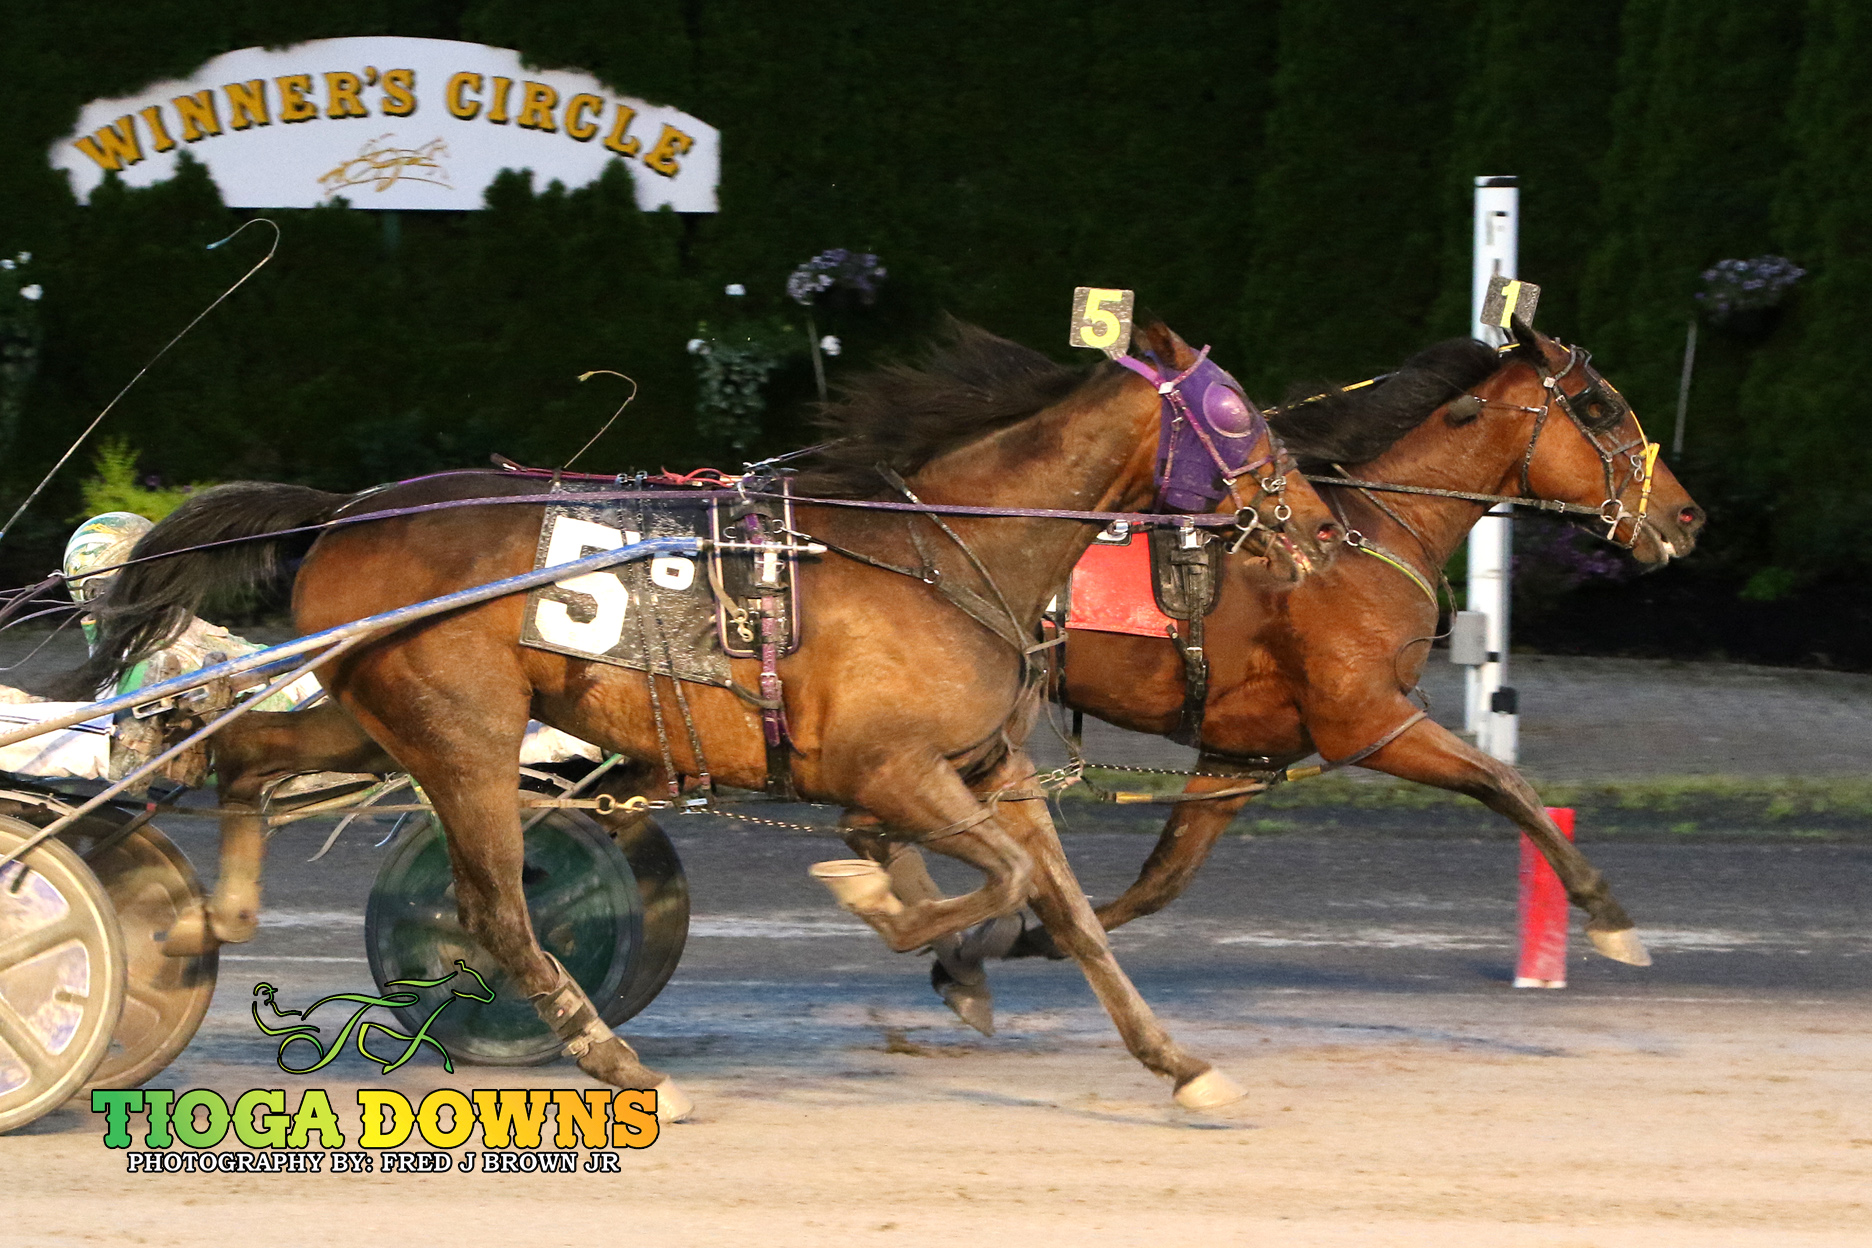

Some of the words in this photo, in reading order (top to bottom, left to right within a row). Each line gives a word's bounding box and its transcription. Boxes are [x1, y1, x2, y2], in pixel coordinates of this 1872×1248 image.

[73, 66, 417, 172] WINNER'S
[445, 70, 695, 180] CIRCLE
[1080, 288, 1123, 349] 5
[1500, 279, 1522, 329] 1
[535, 515, 642, 655] 5
